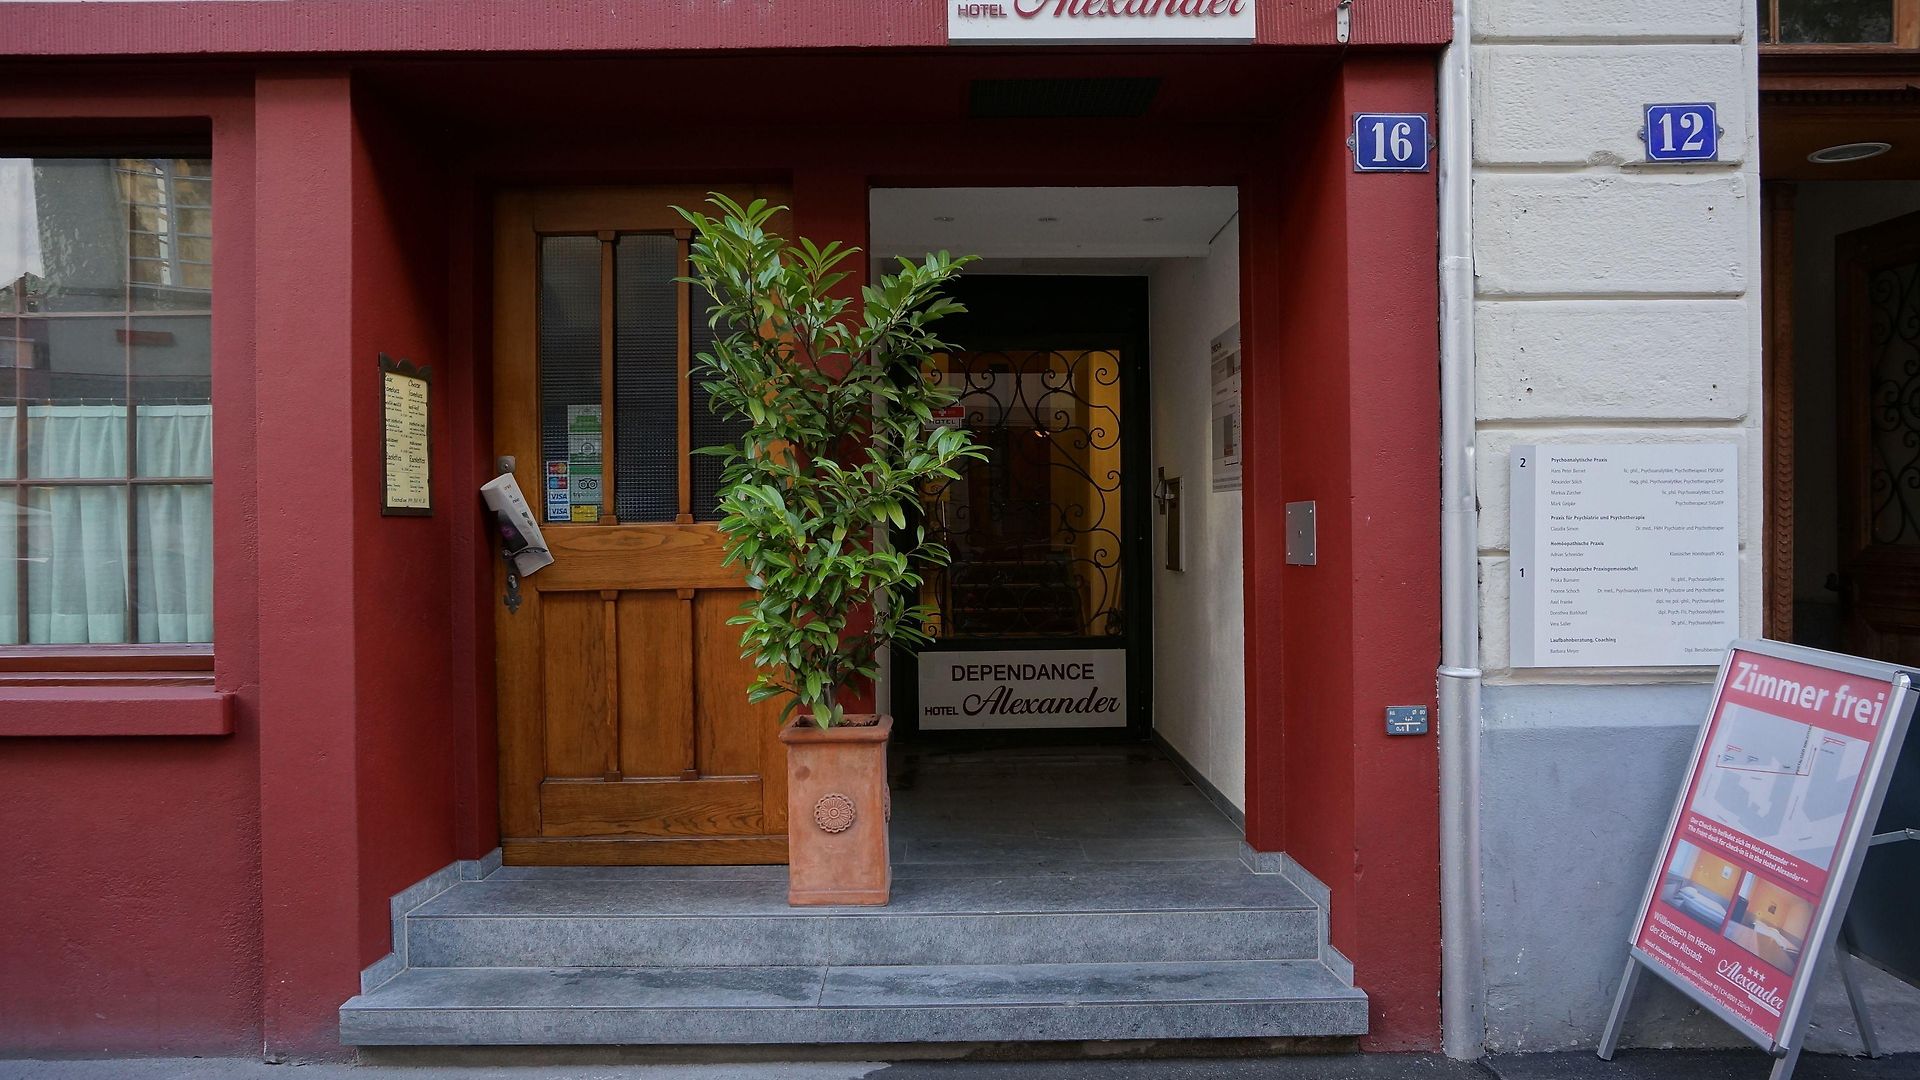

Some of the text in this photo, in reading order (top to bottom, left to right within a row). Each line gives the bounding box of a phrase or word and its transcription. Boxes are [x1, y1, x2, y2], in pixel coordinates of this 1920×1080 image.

[957, 4, 1008, 18] HOTEL
[1371, 121, 1413, 163] 16
[1658, 111, 1706, 152] 12
[1519, 457, 1526, 468] 2
[1519, 568, 1525, 578] 1
[951, 663, 1095, 681] DEPENDANCE
[925, 685, 1121, 716] HOTEL Alexander
[1731, 661, 1885, 726] Zimmer frei
[1699, 819, 1717, 834] Check-in
[1751, 843, 1765, 856] Hotel
[1765, 850, 1789, 866] Alexander
[1726, 842, 1745, 855] check-in
[1762, 859, 1777, 871] Hotel
[1776, 866, 1801, 882] Alexander
[1650, 924, 1661, 934] der
[1659, 929, 1681, 948] Zürcher
[1654, 911, 1716, 955] Willkommen im Herzen
[1717, 959, 1784, 1010] Alexander
